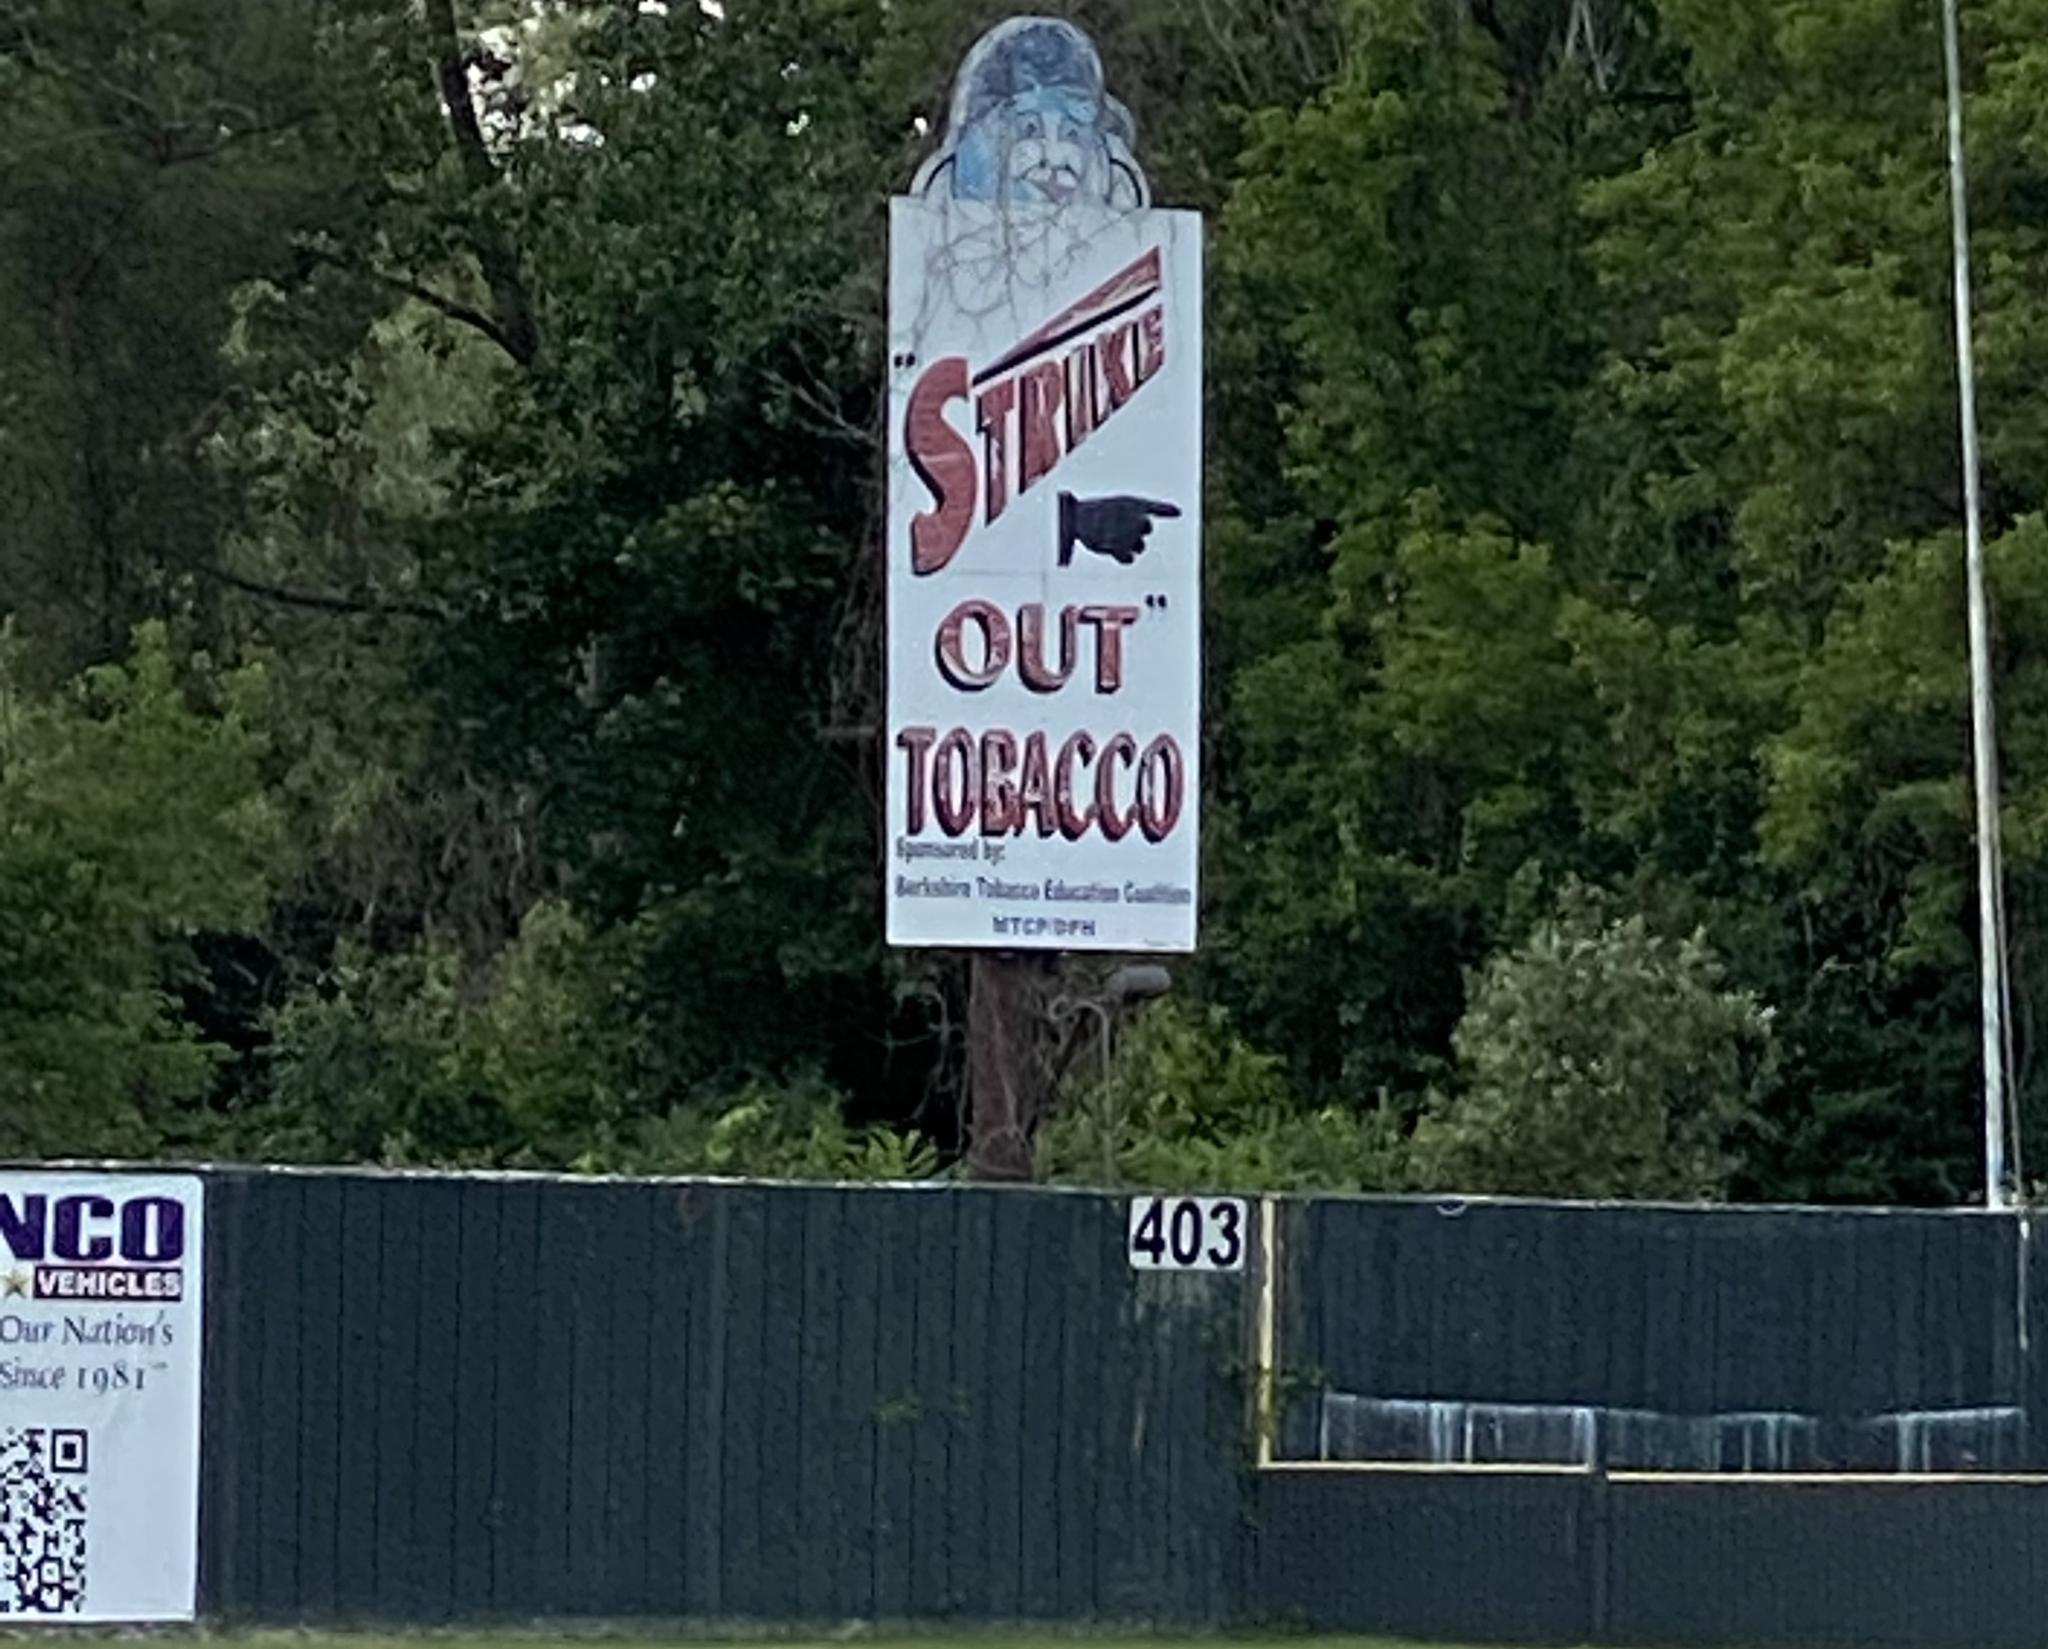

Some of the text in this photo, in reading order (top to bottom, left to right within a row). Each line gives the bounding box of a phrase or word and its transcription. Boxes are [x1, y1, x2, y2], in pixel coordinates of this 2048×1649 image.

[896, 726, 1185, 844] TOBACCO
[896, 836, 979, 864] Sponsored
[895, 874, 1192, 905] Berkshire Tobacco Education Coalition
[0, 1193, 185, 1263] NCO
[1133, 1199, 1240, 1265] 403
[37, 1271, 182, 1297] VEHICLES
[0, 1309, 174, 1347] Our Nation's
[0, 1356, 66, 1389] Since
